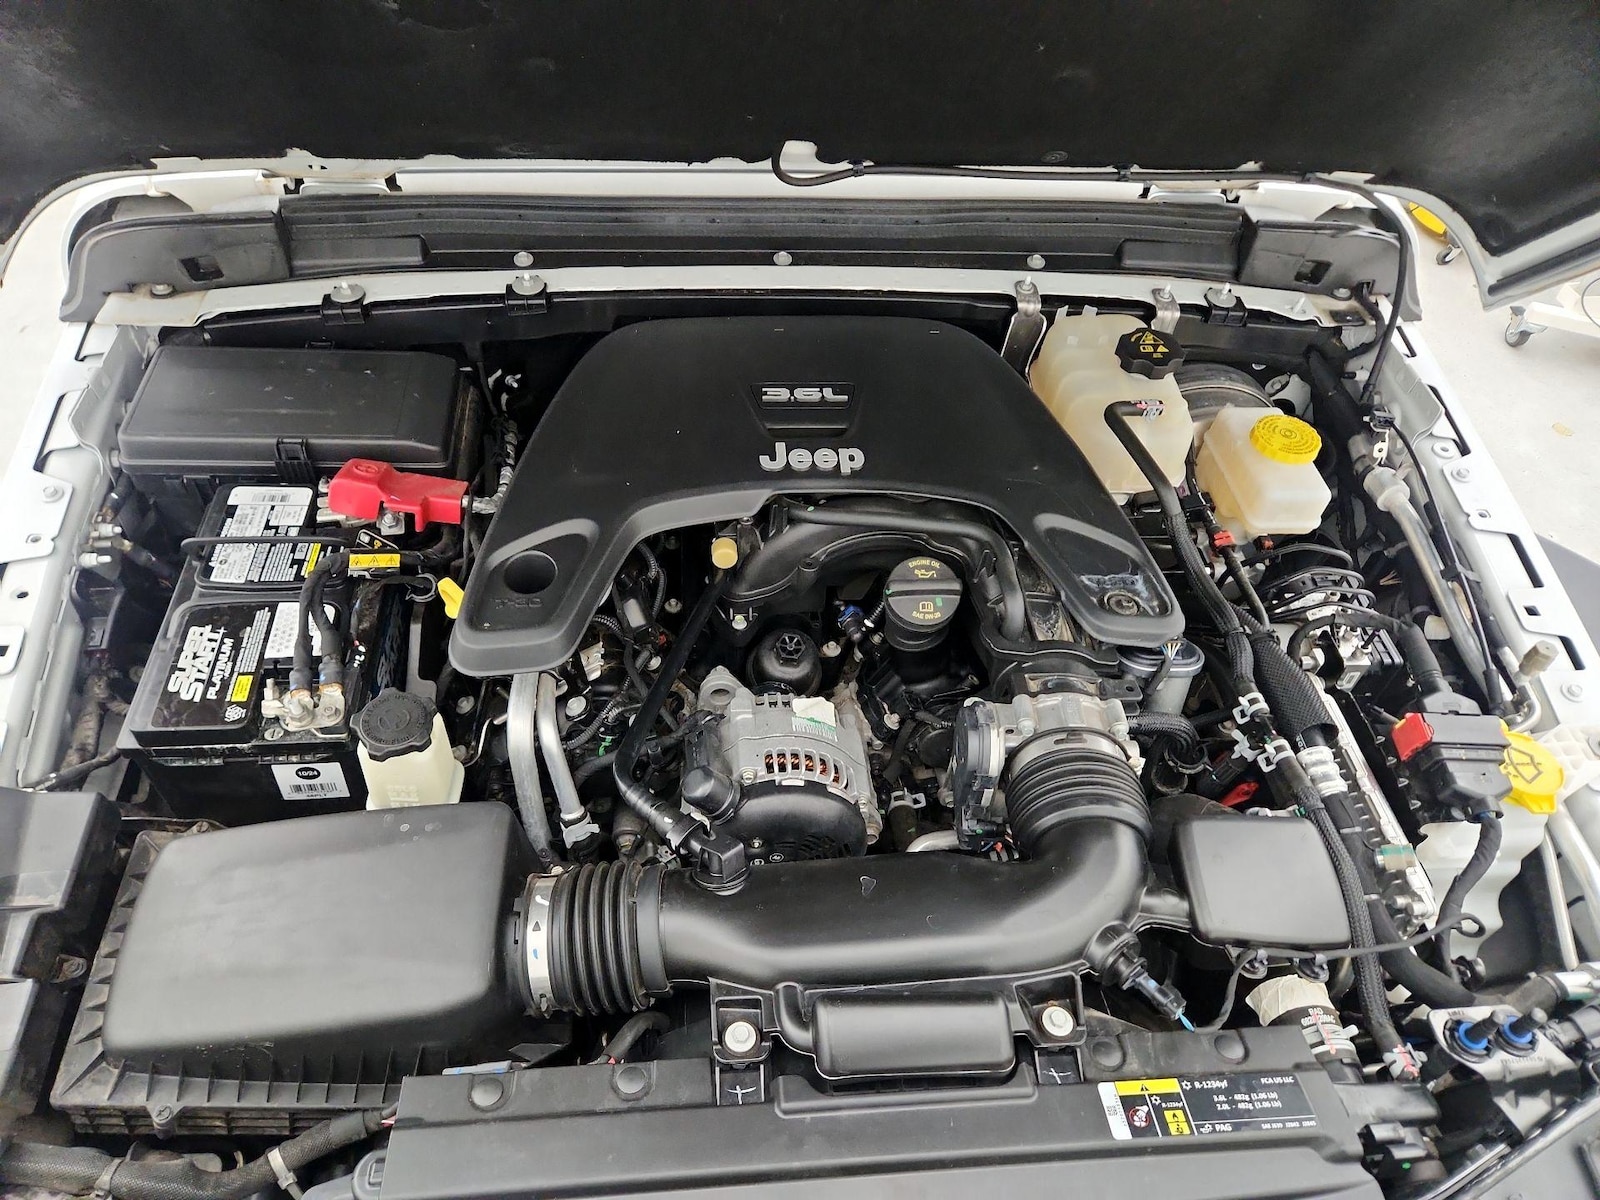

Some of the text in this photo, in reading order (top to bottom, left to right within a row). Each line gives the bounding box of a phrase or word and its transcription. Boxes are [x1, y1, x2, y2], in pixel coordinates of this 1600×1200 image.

[762, 387, 849, 403] 3.6L
[759, 441, 866, 476] Jeep
[908, 560, 941, 569] ENGINE OIL
[911, 610, 942, 620] SAE 0W-20
[167, 626, 207, 693] SUPER
[179, 625, 221, 703] START
[206, 638, 235, 700] PLATINUM
[1194, 1079, 1229, 1090] R-1234yf
[1260, 1077, 1274, 1085] FCA
[1283, 1075, 1295, 1083] LLC
[1214, 1123, 1233, 1132] PAG
